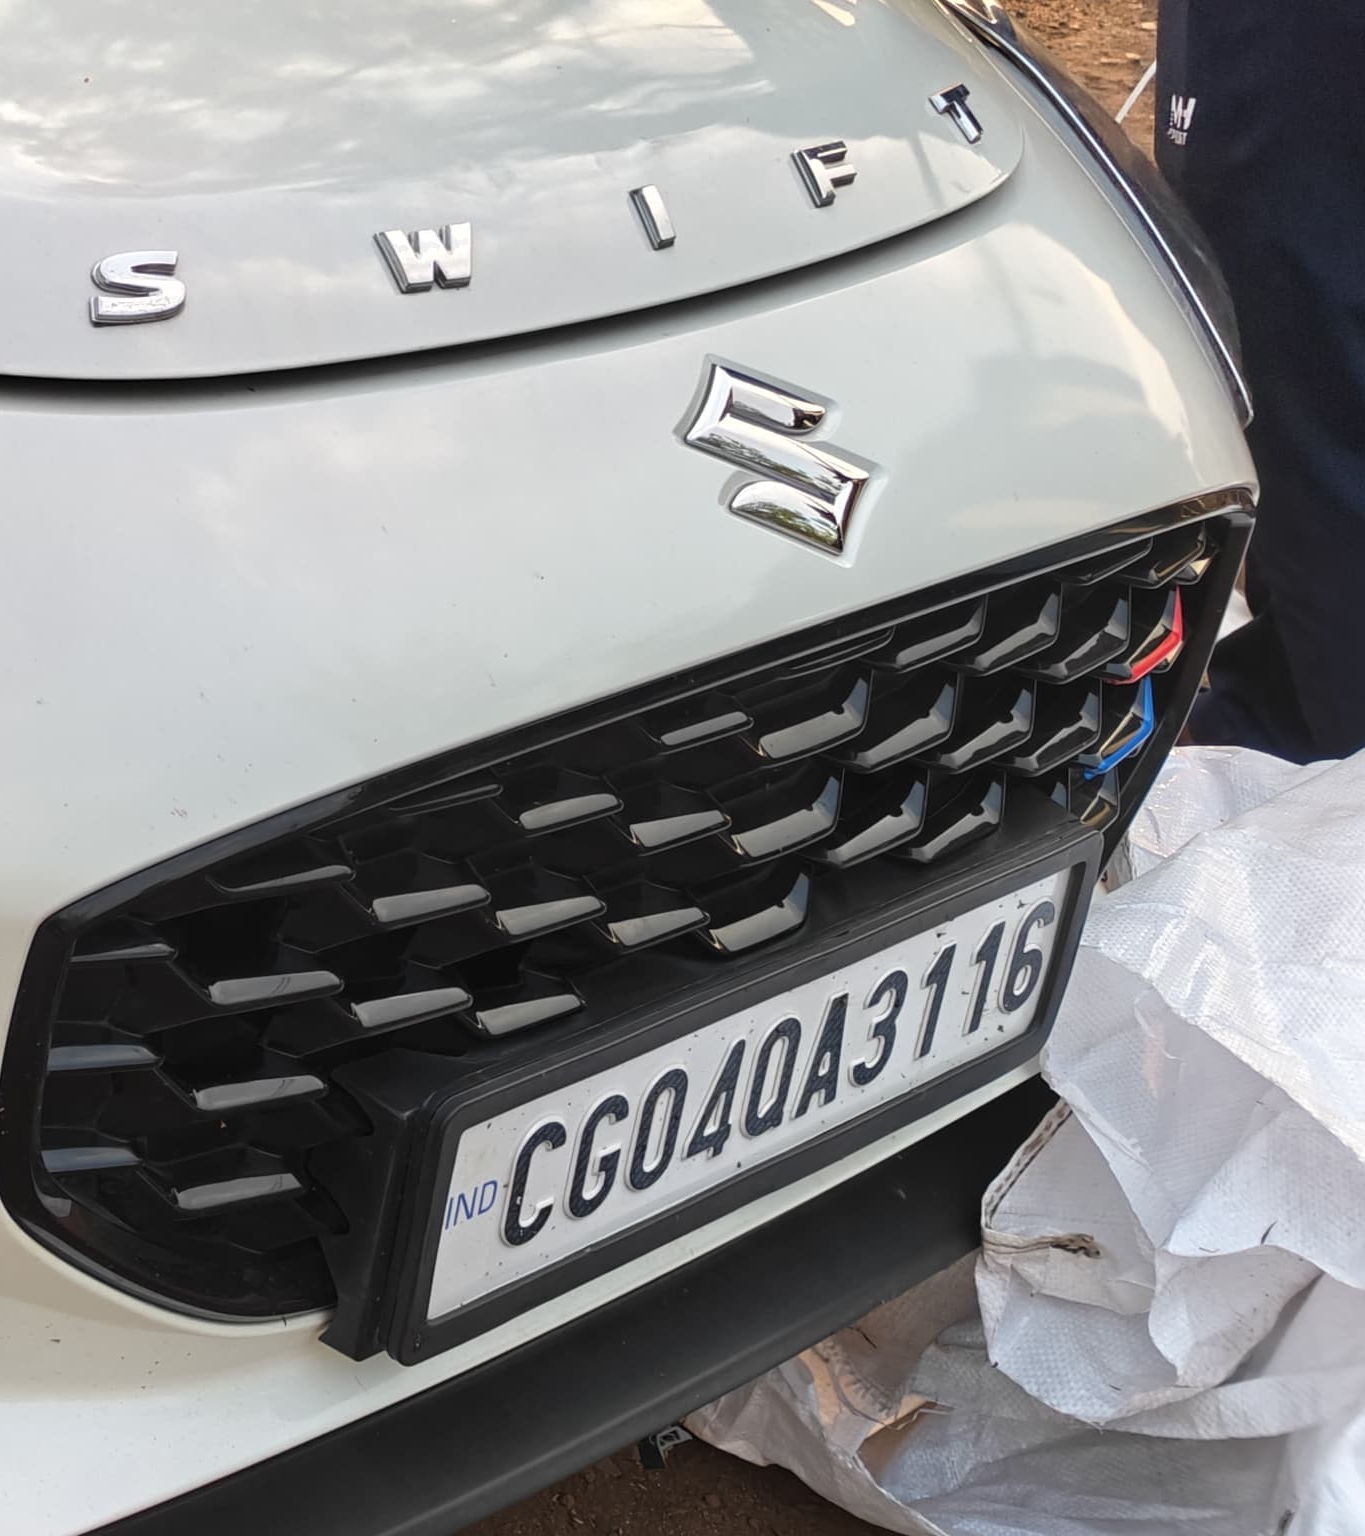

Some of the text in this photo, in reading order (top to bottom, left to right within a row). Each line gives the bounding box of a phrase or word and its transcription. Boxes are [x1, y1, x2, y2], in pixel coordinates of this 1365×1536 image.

[88, 82, 986, 329] SWIFT
[498, 897, 1057, 1248] CG04QA3116
[444, 1178, 499, 1231] IND
